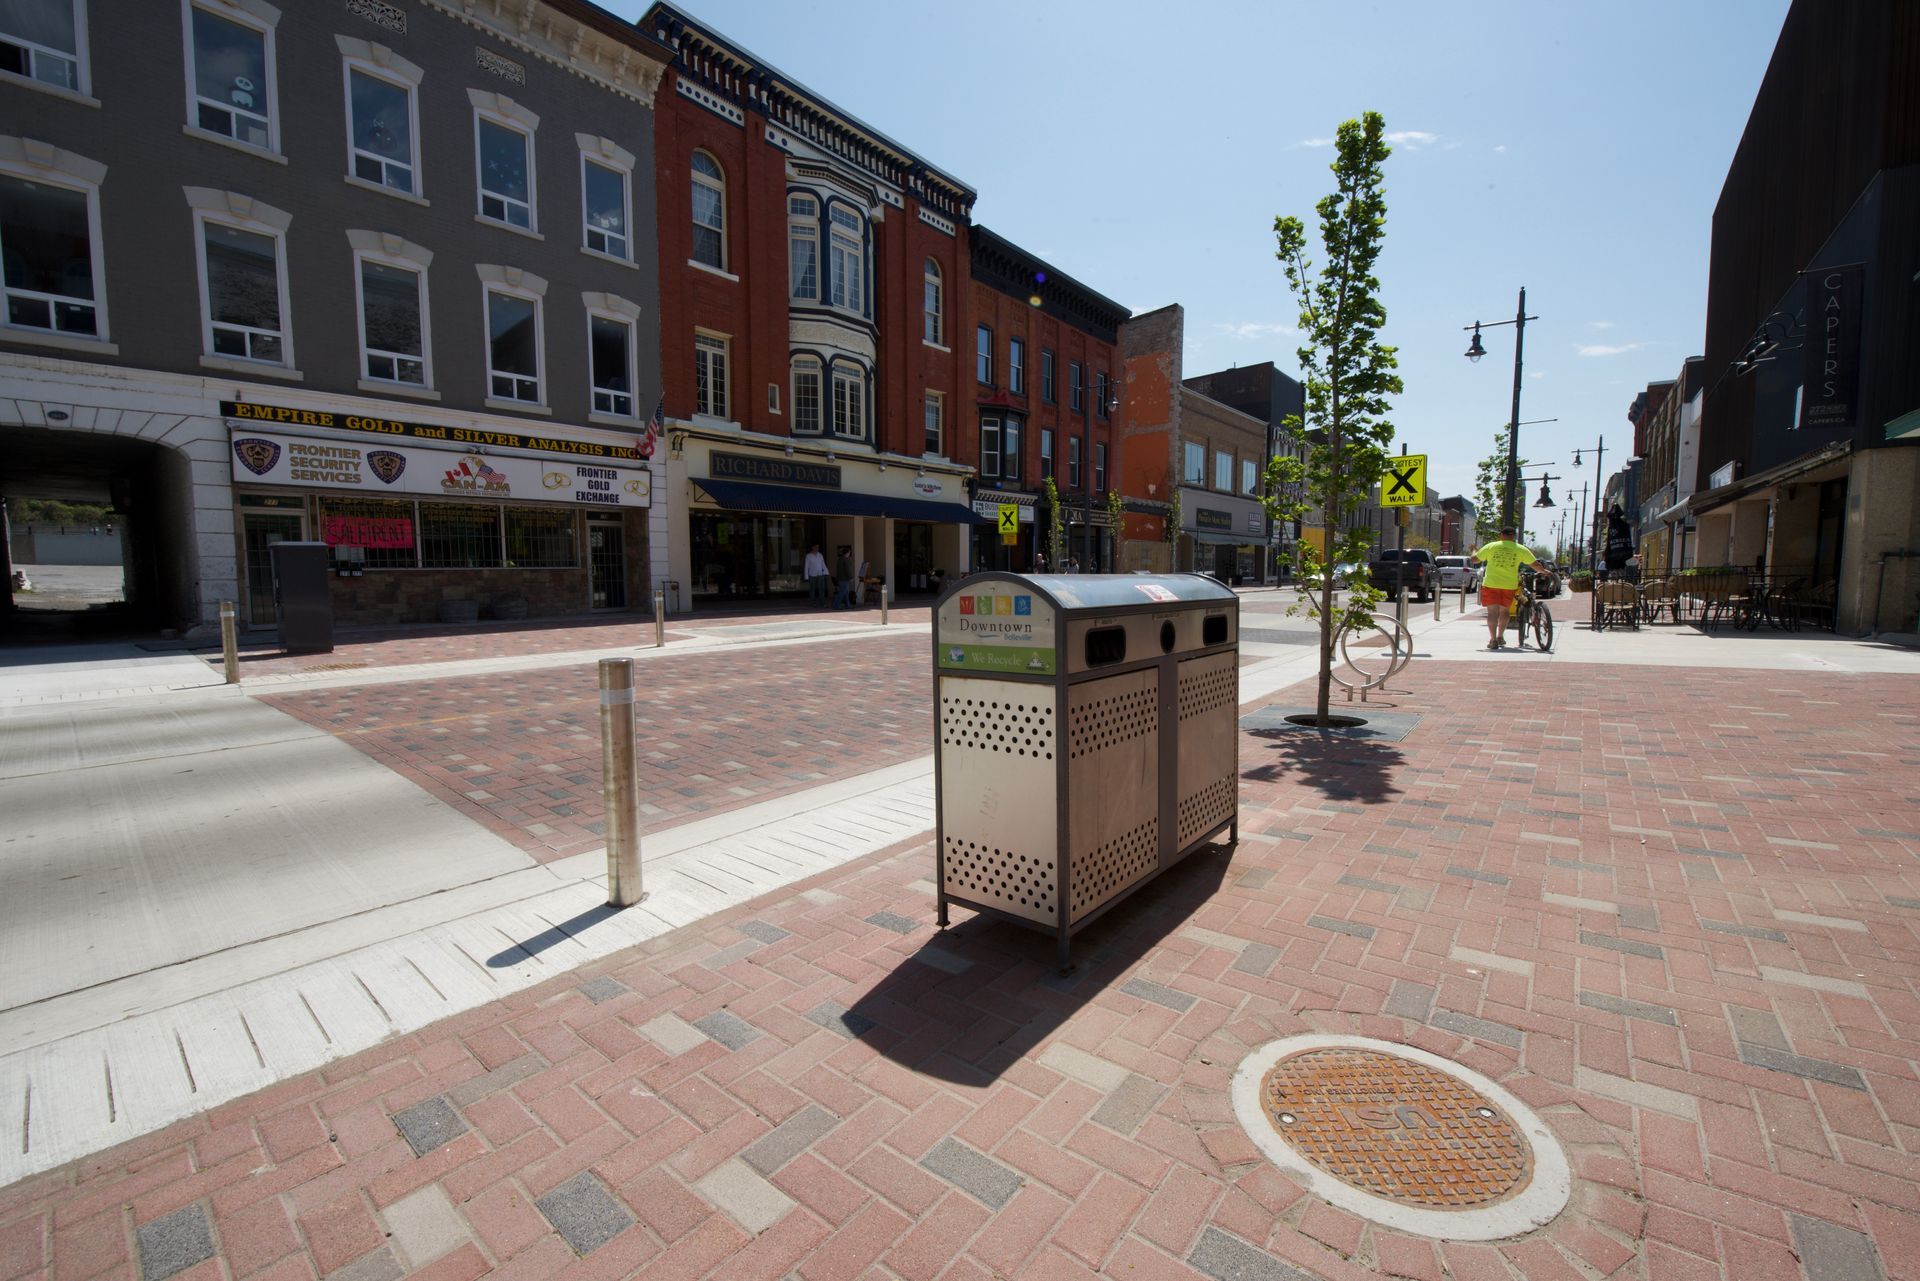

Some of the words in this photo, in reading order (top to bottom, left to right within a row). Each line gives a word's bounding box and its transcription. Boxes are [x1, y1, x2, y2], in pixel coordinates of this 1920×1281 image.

[1823, 273, 1843, 398] CAPERS
[233, 402, 335, 427] EMPIRE
[345, 415, 405, 434] GOLD
[414, 425, 447, 439] and
[453, 429, 521, 448] SILVER
[527, 437, 605, 457] ANALYSIS
[610, 447, 641, 460] INC.
[288, 443, 362, 460] FRONTIER
[289, 456, 362, 472] SECURITY
[715, 456, 793, 480] RICHARD
[796, 464, 839, 483] DAVIS
[291, 469, 362, 484] SERVICES
[577, 466, 618, 481] FRONTIER
[440, 478, 511, 493] CAN-AM
[587, 479, 611, 492] GOLD
[576, 490, 620, 504] EXCHANGE
[1389, 495, 1416, 503] WALK
[959, 618, 1033, 634] Downtown
[971, 651, 986, 664] We
[987, 653, 1021, 667] Recycle
[1337, 1105, 1441, 1131] USI
